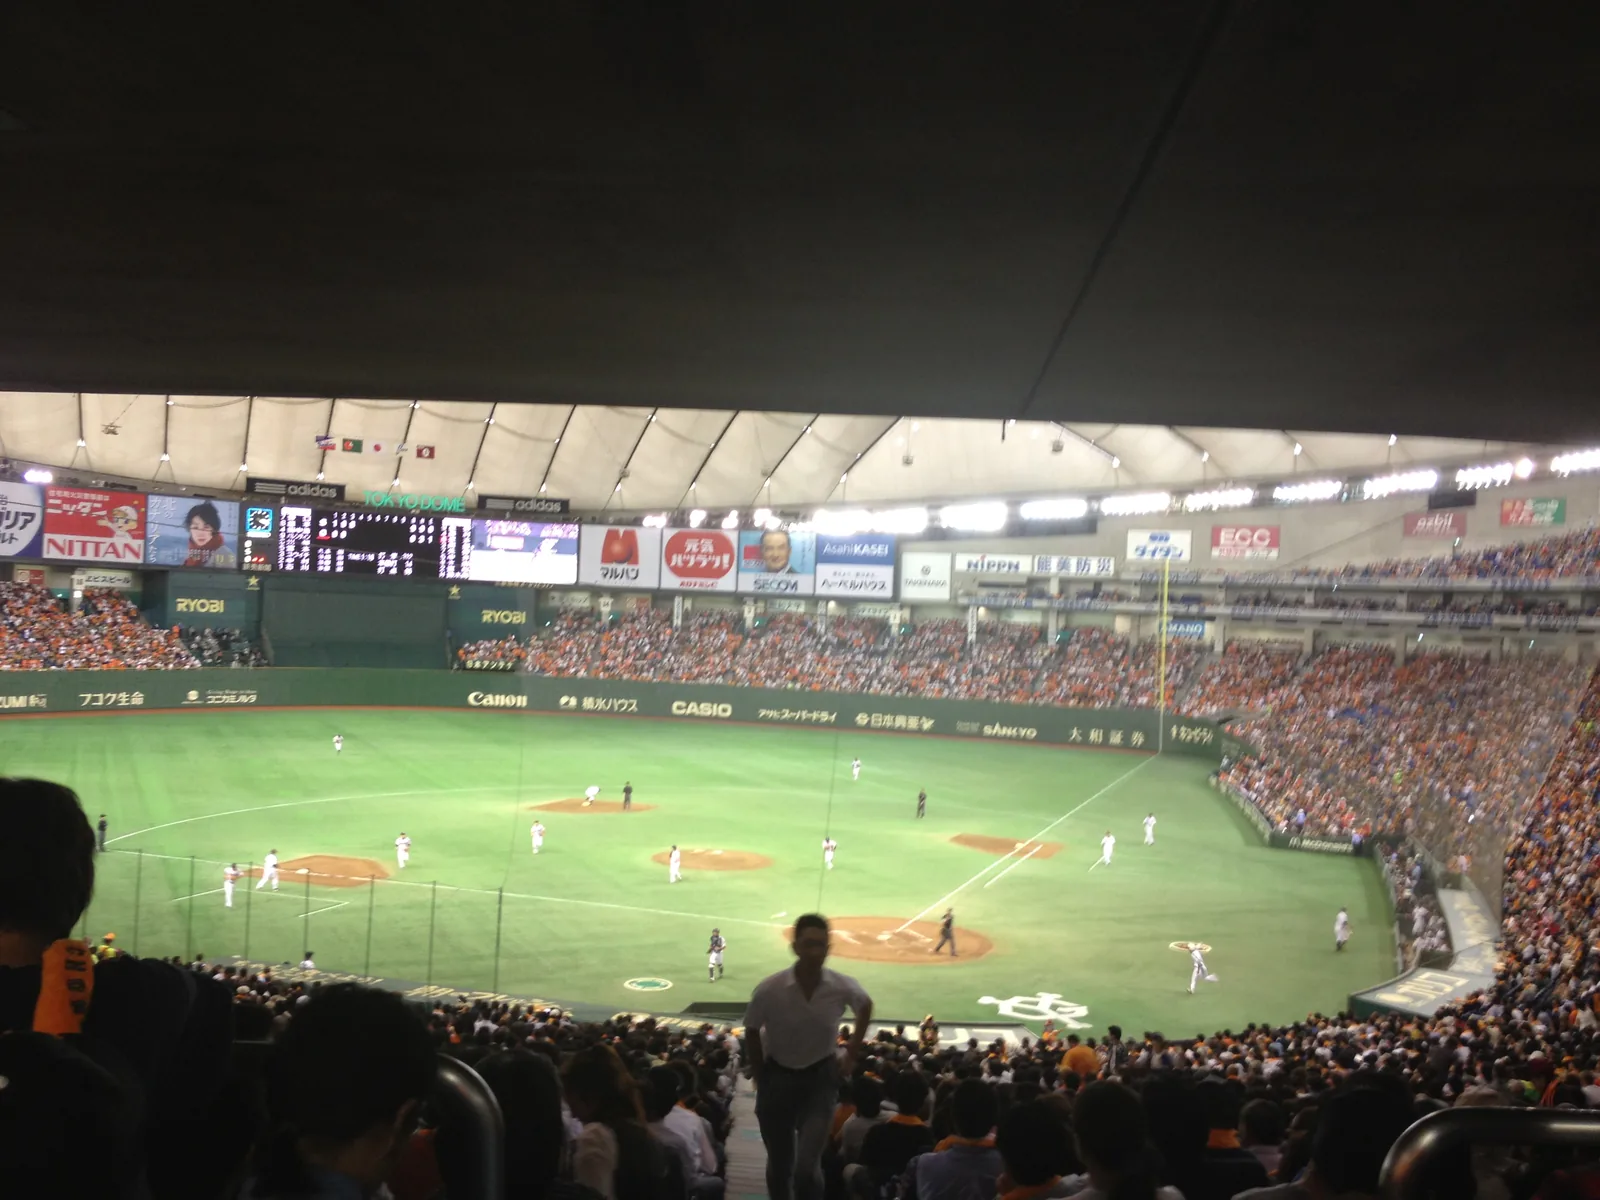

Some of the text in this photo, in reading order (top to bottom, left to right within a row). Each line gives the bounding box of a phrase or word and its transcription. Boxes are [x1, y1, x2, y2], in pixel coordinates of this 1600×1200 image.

[287, 484, 337, 499] adidas
[363, 491, 465, 513] TOKYO DOME
[515, 498, 561, 513] adidas
[47, 538, 142, 560] NITTAN
[684, 538, 714, 555] 元気
[600, 567, 640, 582] マルハン
[753, 578, 799, 593] SECOM
[176, 598, 225, 613] RYOBI
[481, 609, 527, 625] RYOBI
[78, 691, 145, 708] フコク生命
[467, 691, 528, 708] Canon
[581, 697, 638, 713] 積水ハウス
[671, 700, 733, 719] CASIO
[1068, 726, 1146, 748] 大和証券
